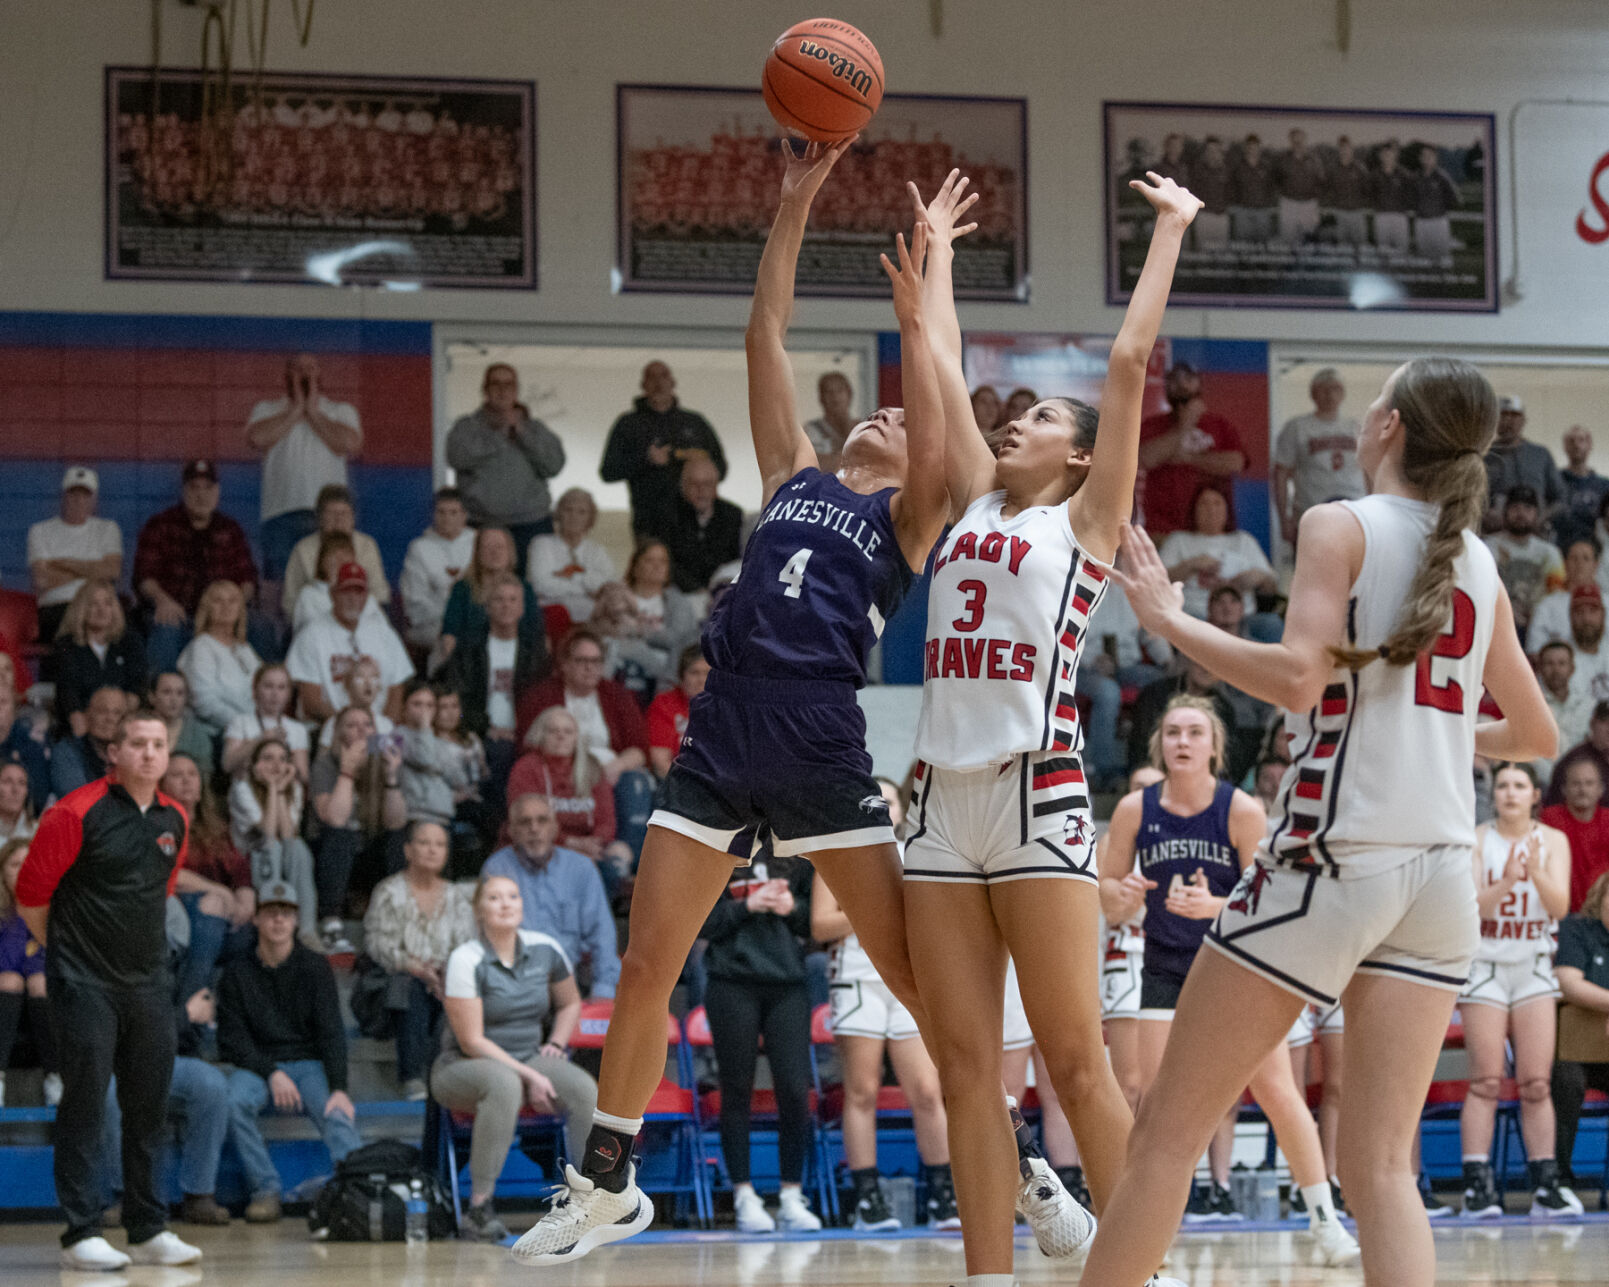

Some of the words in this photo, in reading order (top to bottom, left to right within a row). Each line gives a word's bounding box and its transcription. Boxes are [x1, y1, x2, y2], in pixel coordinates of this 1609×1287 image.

[800, 40, 873, 98] Wilson
[778, 548, 814, 599] 4
[952, 579, 987, 632] 3
[925, 637, 1037, 682] RAVES
[1141, 838, 1231, 868] LANESVILLE
[1500, 891, 1528, 917] 21
